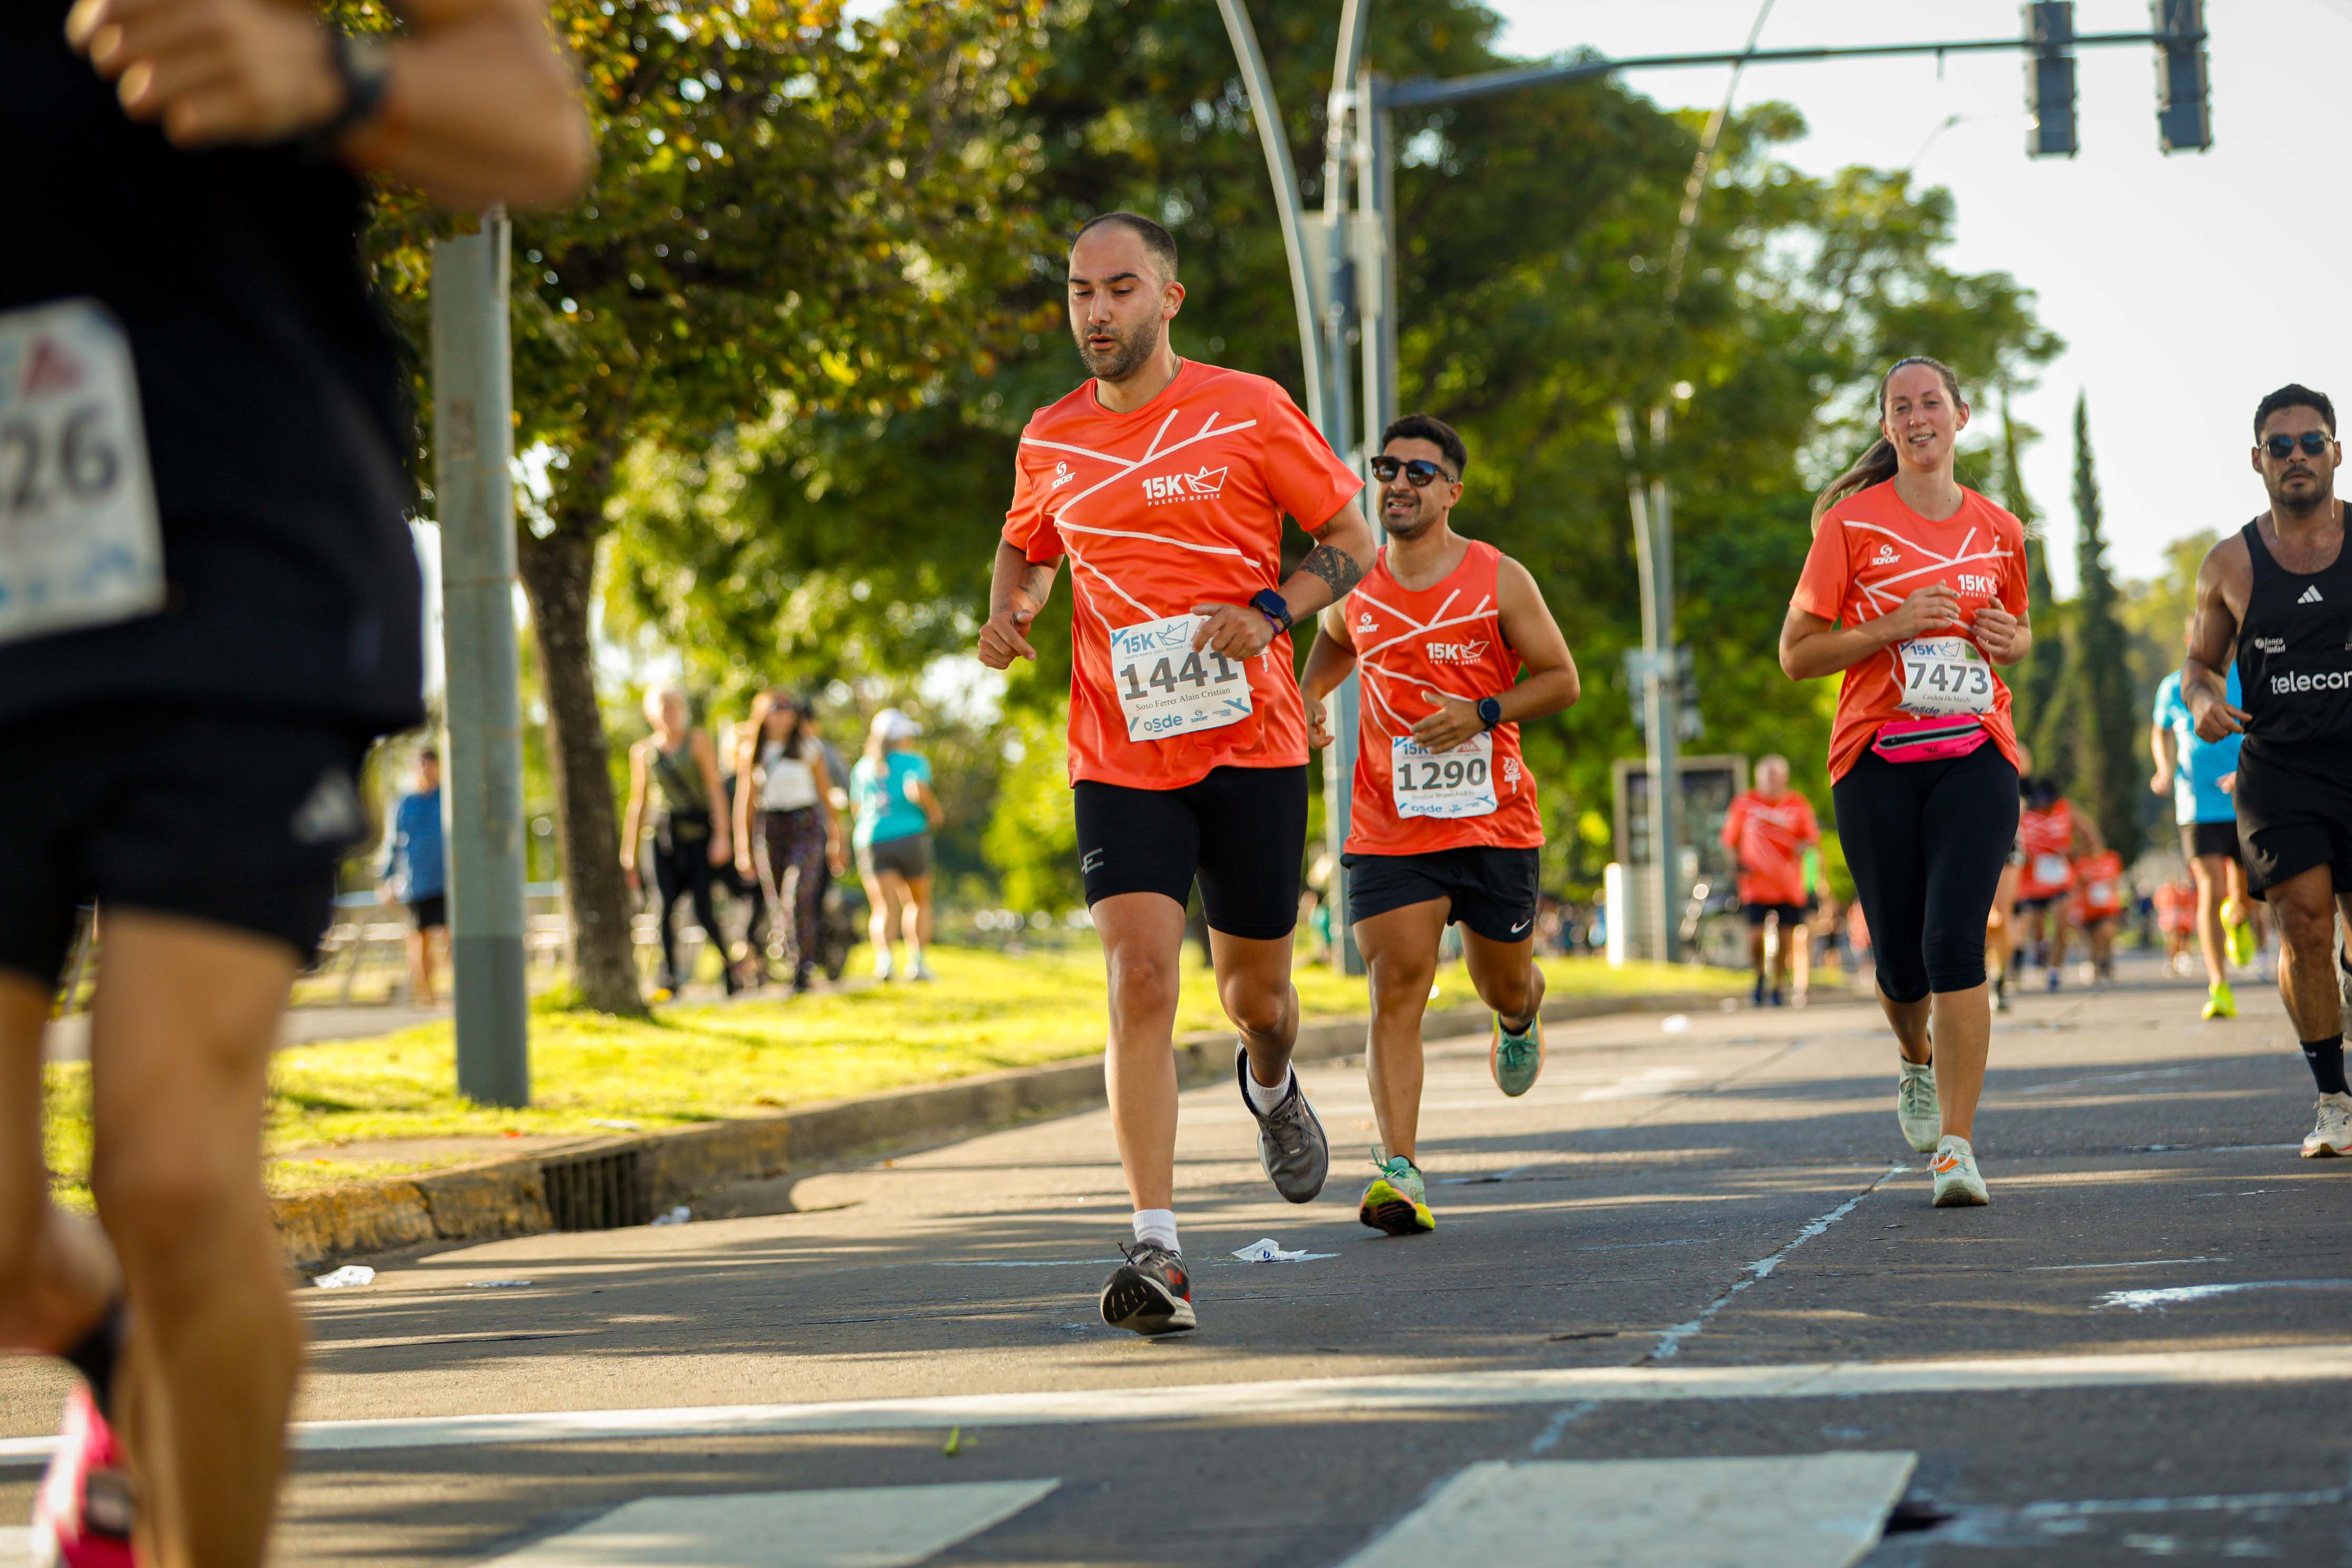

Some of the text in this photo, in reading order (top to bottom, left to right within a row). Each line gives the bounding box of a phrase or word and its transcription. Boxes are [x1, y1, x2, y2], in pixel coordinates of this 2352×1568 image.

[1142, 474, 1184, 499] 15K
[1148, 497, 1185, 506] PUERTO
[1958, 574, 1986, 593] 15K
[1123, 633, 1155, 654] 15K
[1426, 642, 1458, 660] 15K
[1910, 644, 1936, 655] 15K
[1120, 652, 1238, 700] 1441
[1907, 662, 1988, 694] 7473
[1155, 698, 1177, 708] Ferrer
[1180, 693, 1200, 703] Alain
[1201, 688, 1231, 698] Cristian
[1144, 713, 1183, 732] osde
[1398, 758, 1486, 791] 1290
[1411, 804, 1443, 814] osde
